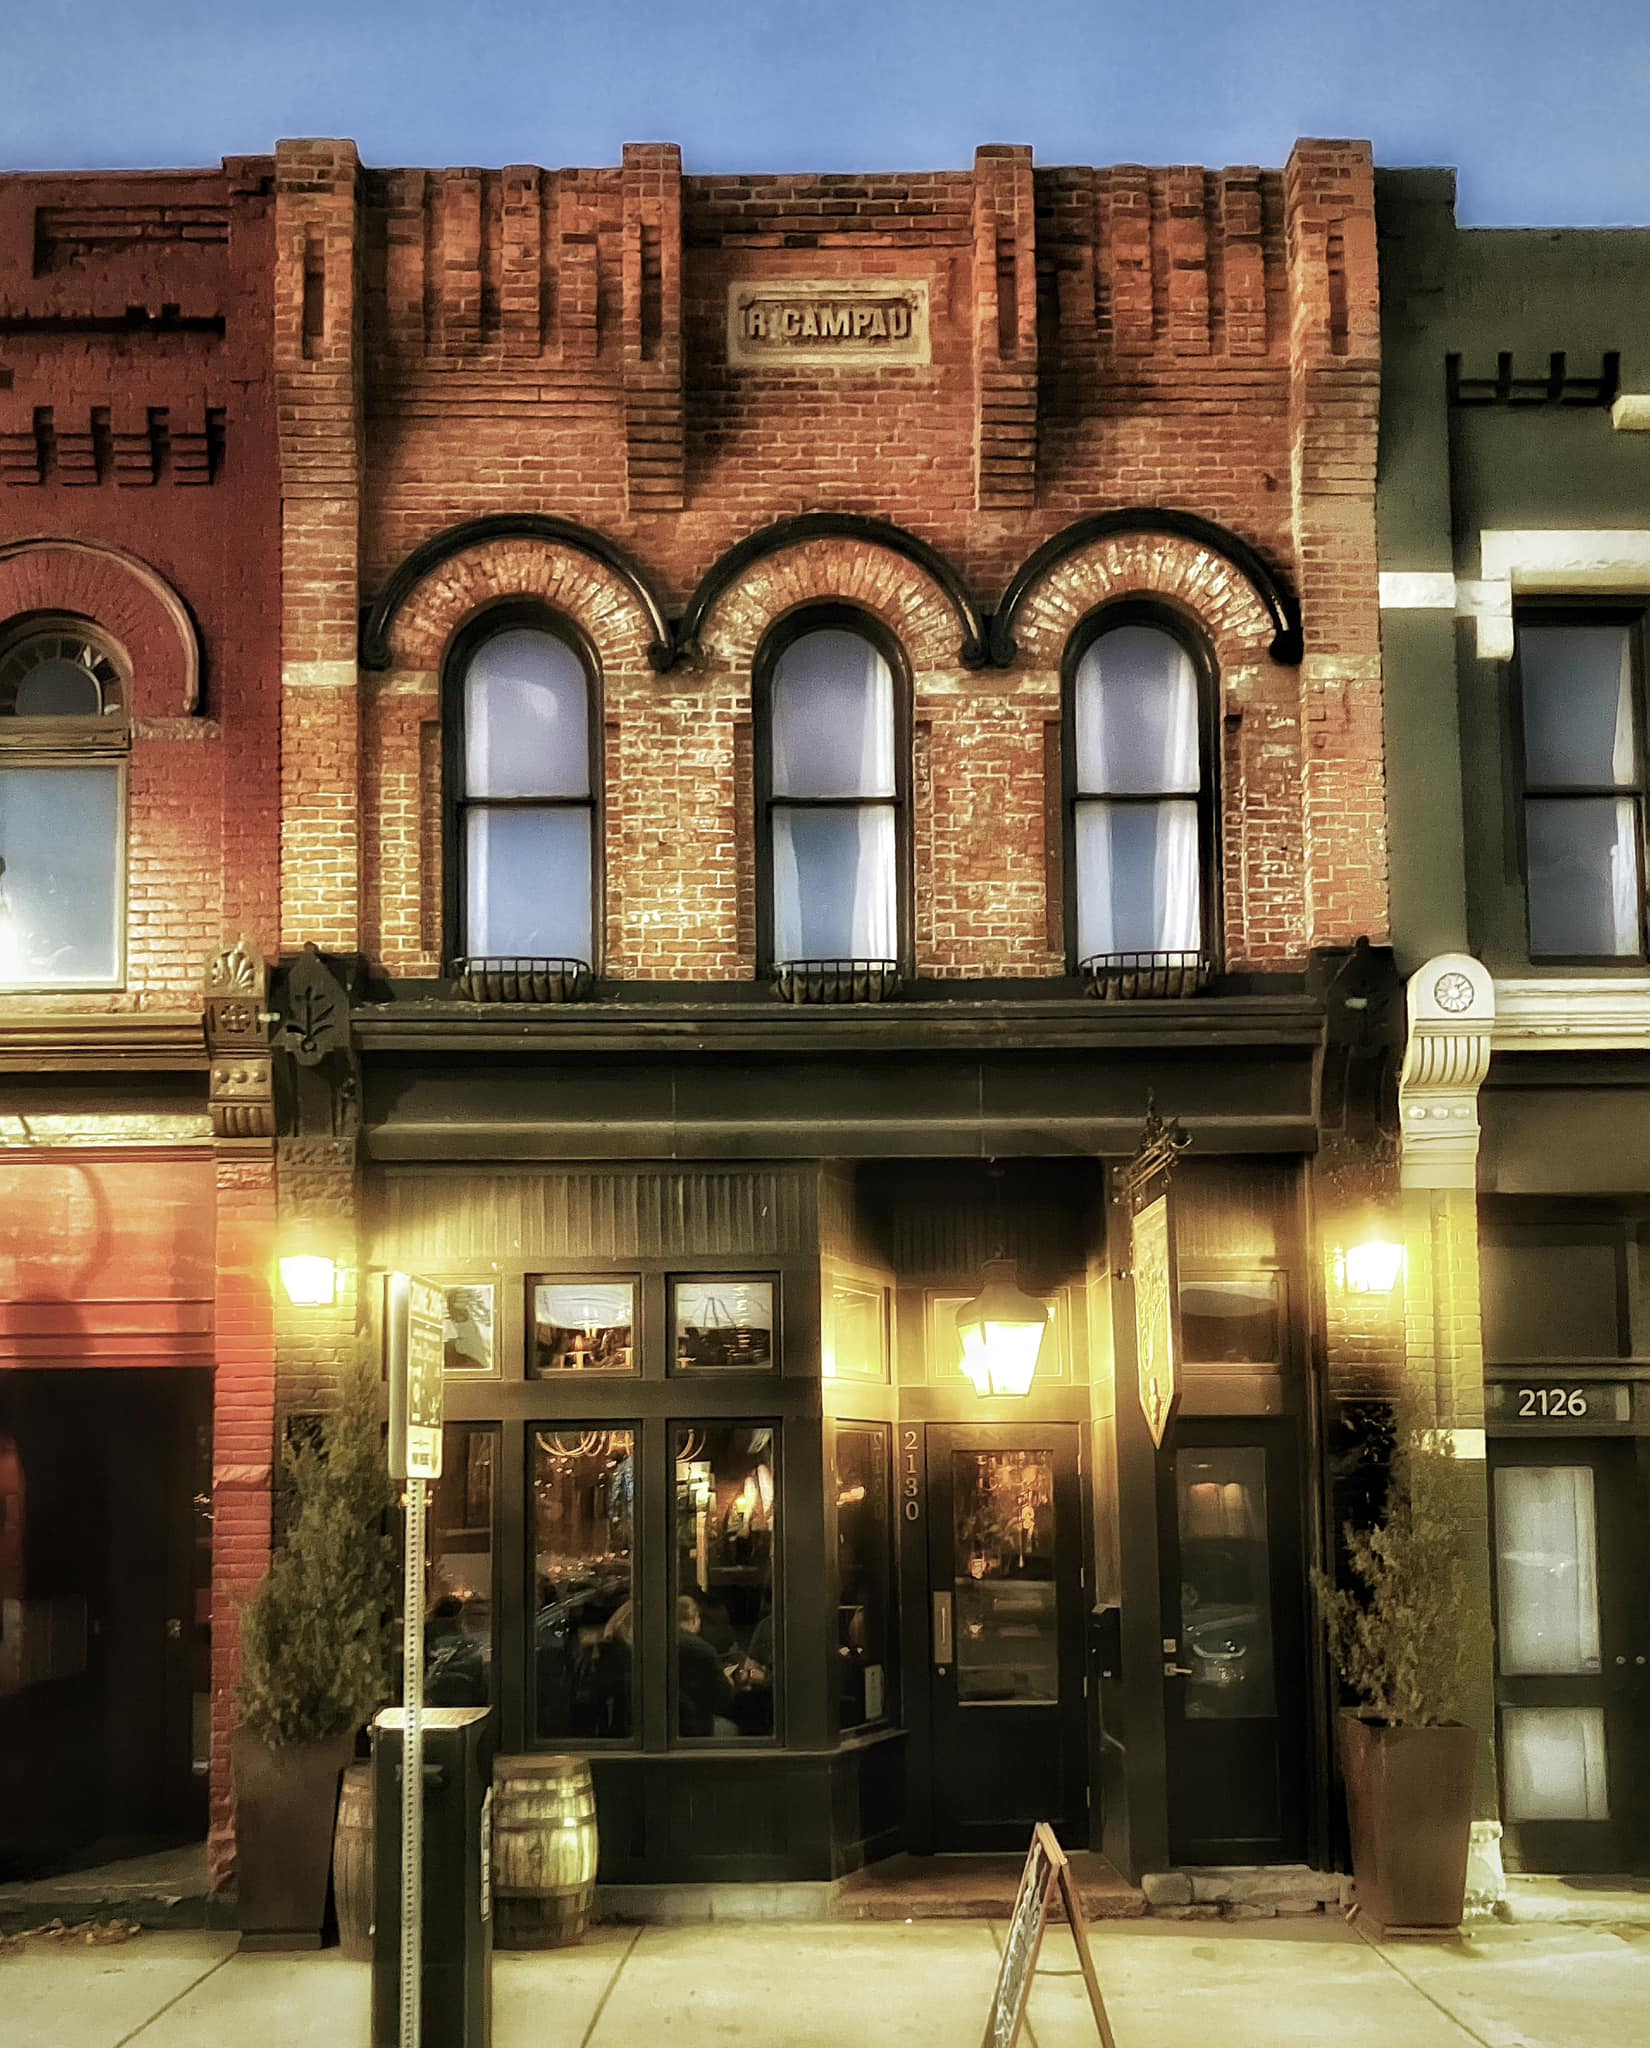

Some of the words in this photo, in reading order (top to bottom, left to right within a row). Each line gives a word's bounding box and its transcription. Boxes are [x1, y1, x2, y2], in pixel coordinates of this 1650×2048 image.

[781, 305, 910, 338] CAMPAU
[1518, 1388, 1588, 1417] 2126
[904, 1430, 920, 1521] 2130
